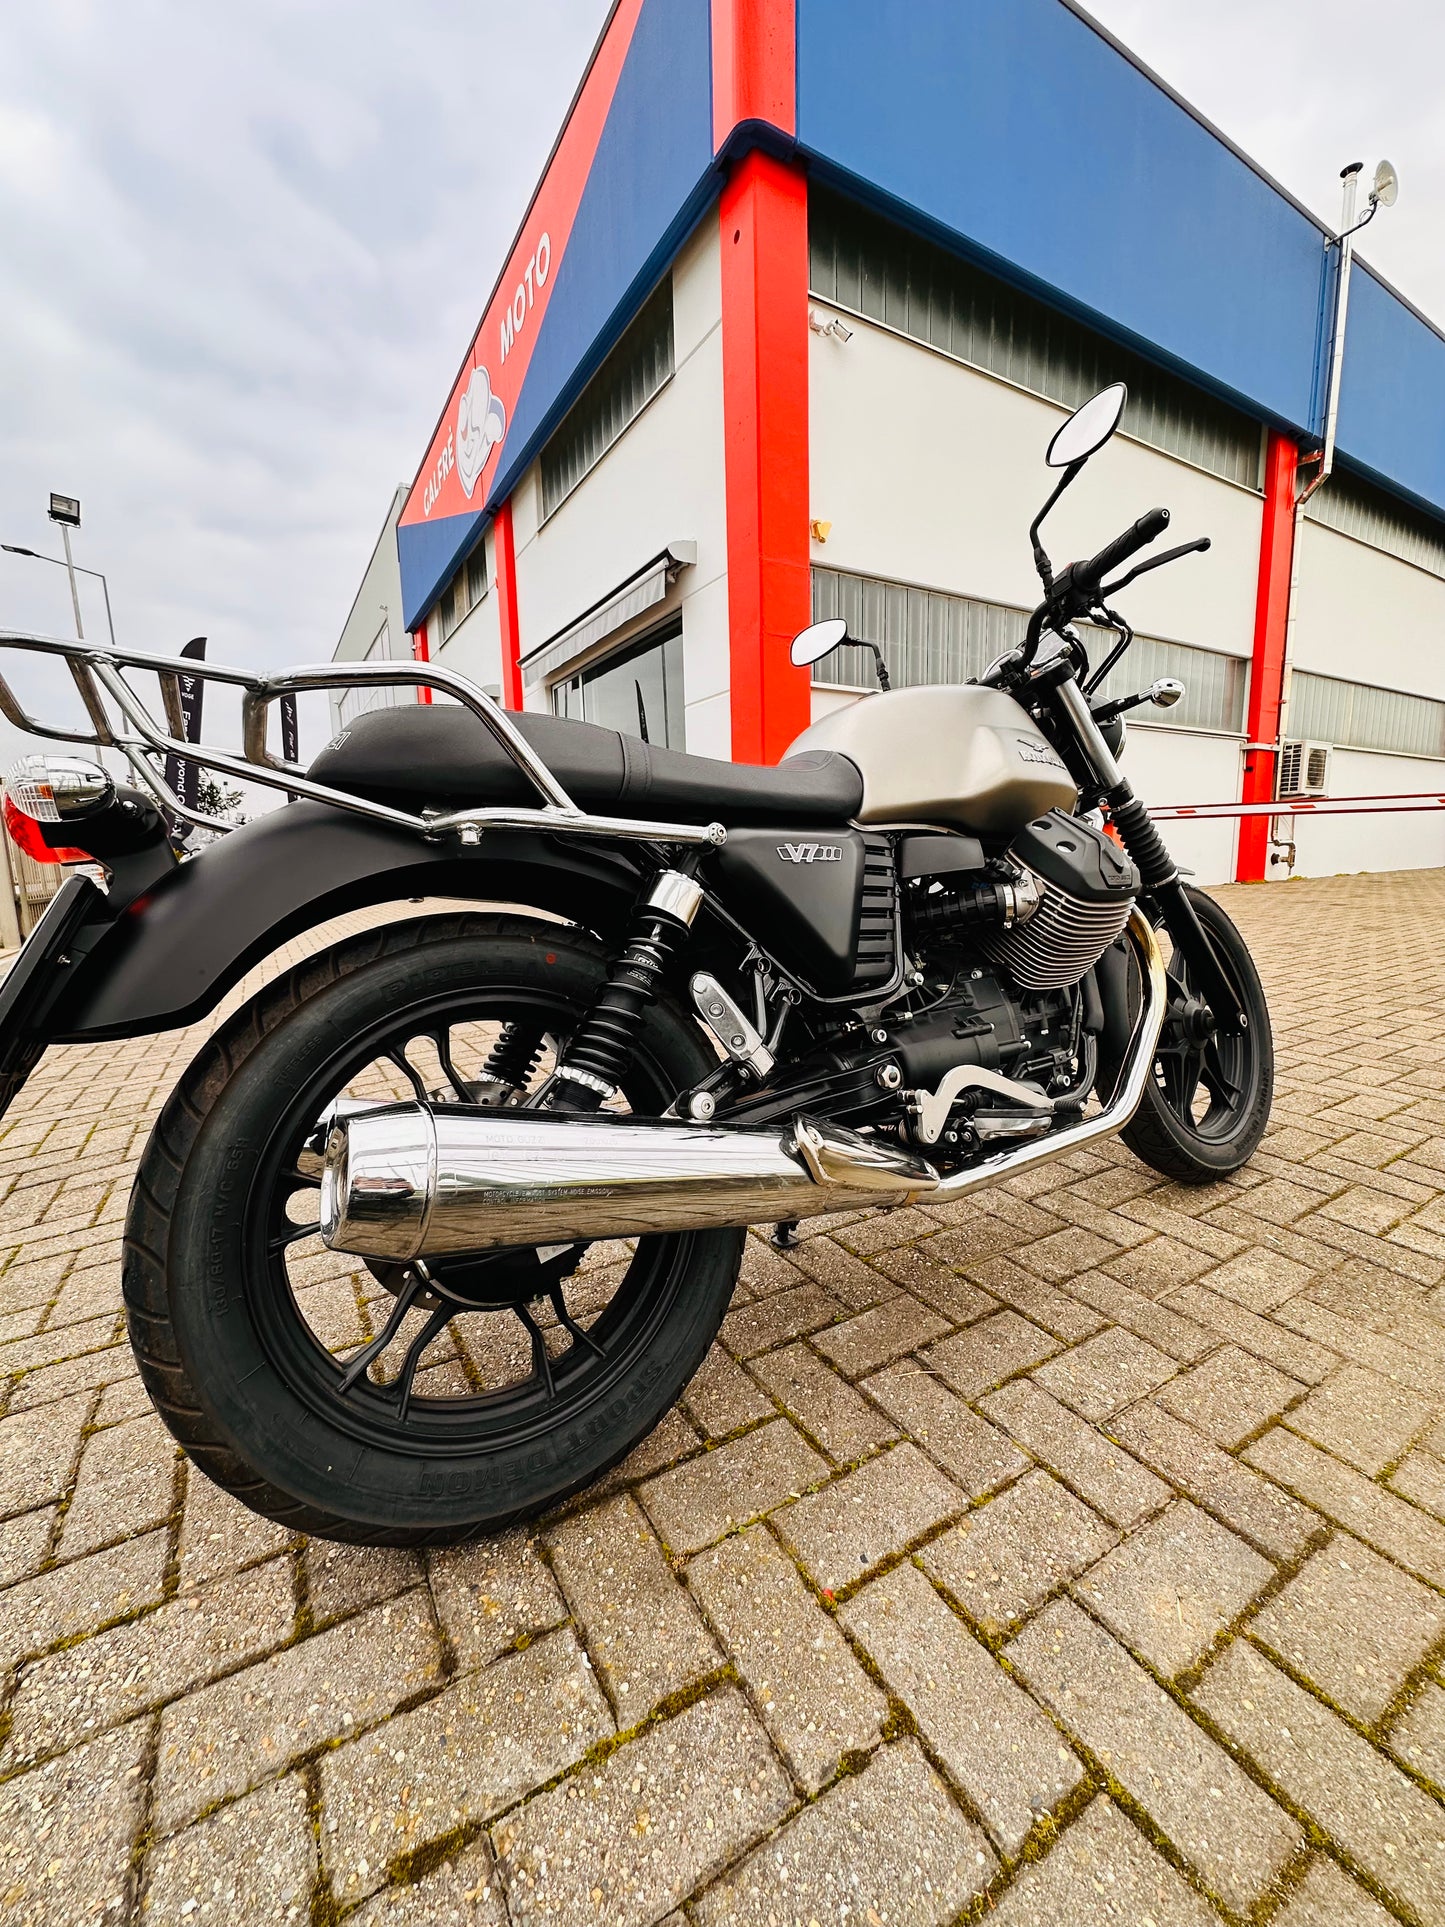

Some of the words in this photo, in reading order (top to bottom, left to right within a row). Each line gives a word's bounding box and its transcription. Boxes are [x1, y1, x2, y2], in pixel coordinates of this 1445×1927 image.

[499, 231, 551, 365] MOTO
[784, 843, 819, 863] V7
[379, 959, 539, 1002] PIRELLI
[274, 1036, 321, 1085] TUBELESS
[214, 1181, 234, 1218] M/C
[208, 1226, 230, 1318] 130/80-17
[567, 1361, 666, 1454] SPORT
[418, 1447, 555, 1497] DEMON
